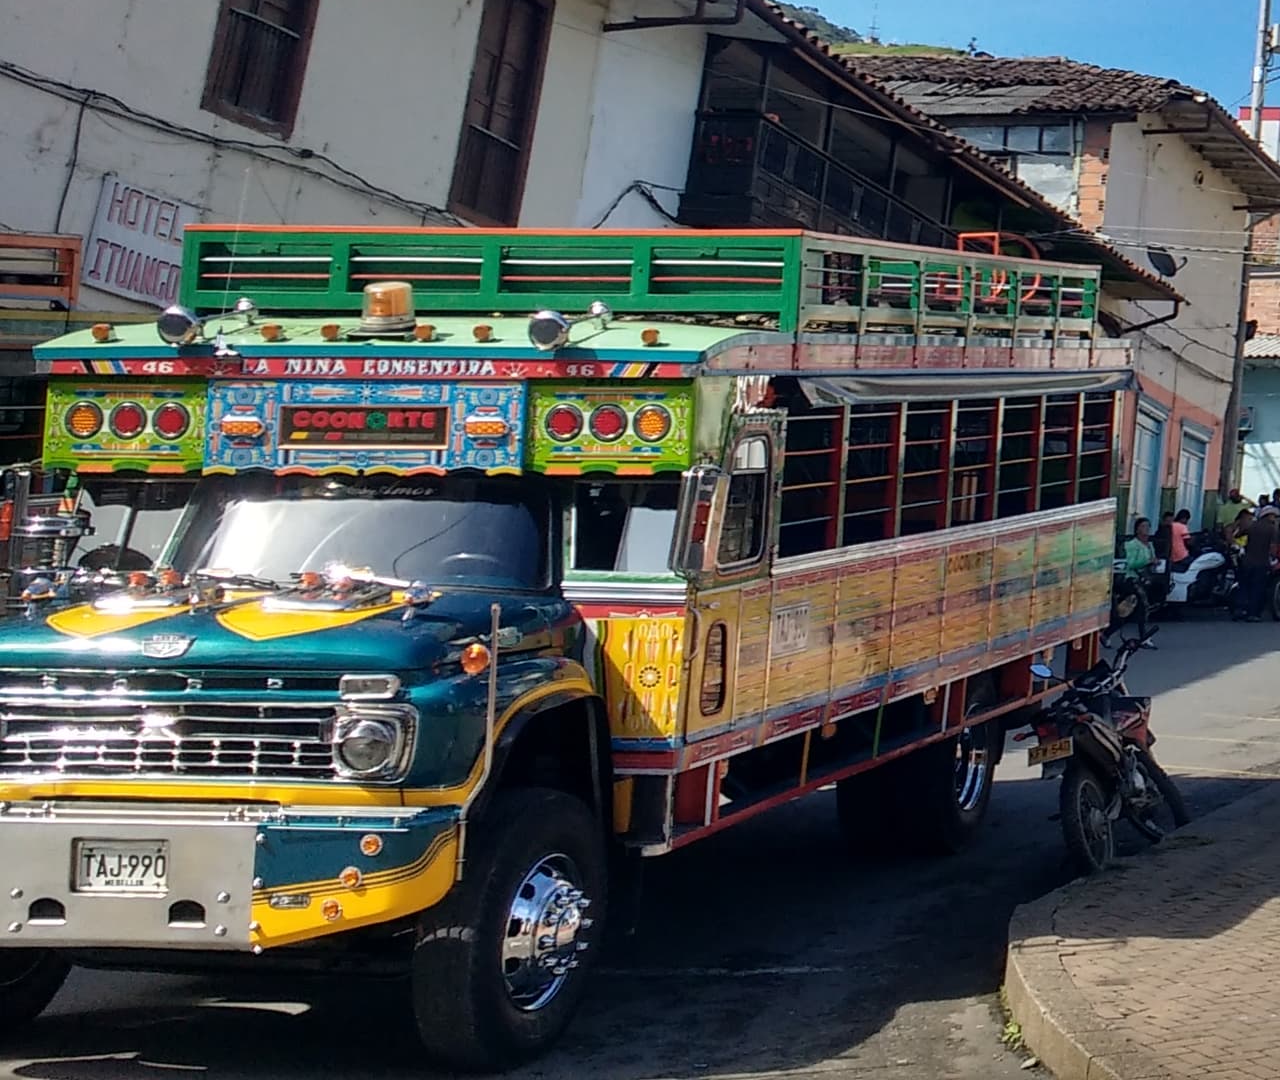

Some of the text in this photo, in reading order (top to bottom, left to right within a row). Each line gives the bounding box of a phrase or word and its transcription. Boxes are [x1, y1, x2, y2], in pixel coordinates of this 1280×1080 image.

[107, 182, 183, 247] HOTEL
[88, 237, 182, 305] ITUANGO
[142, 361, 176, 374] 46
[242, 358, 271, 374] LA
[566, 364, 595, 377] 46
[292, 410, 437, 430] COONORTE
[83, 854, 166, 879] TAJ-990
